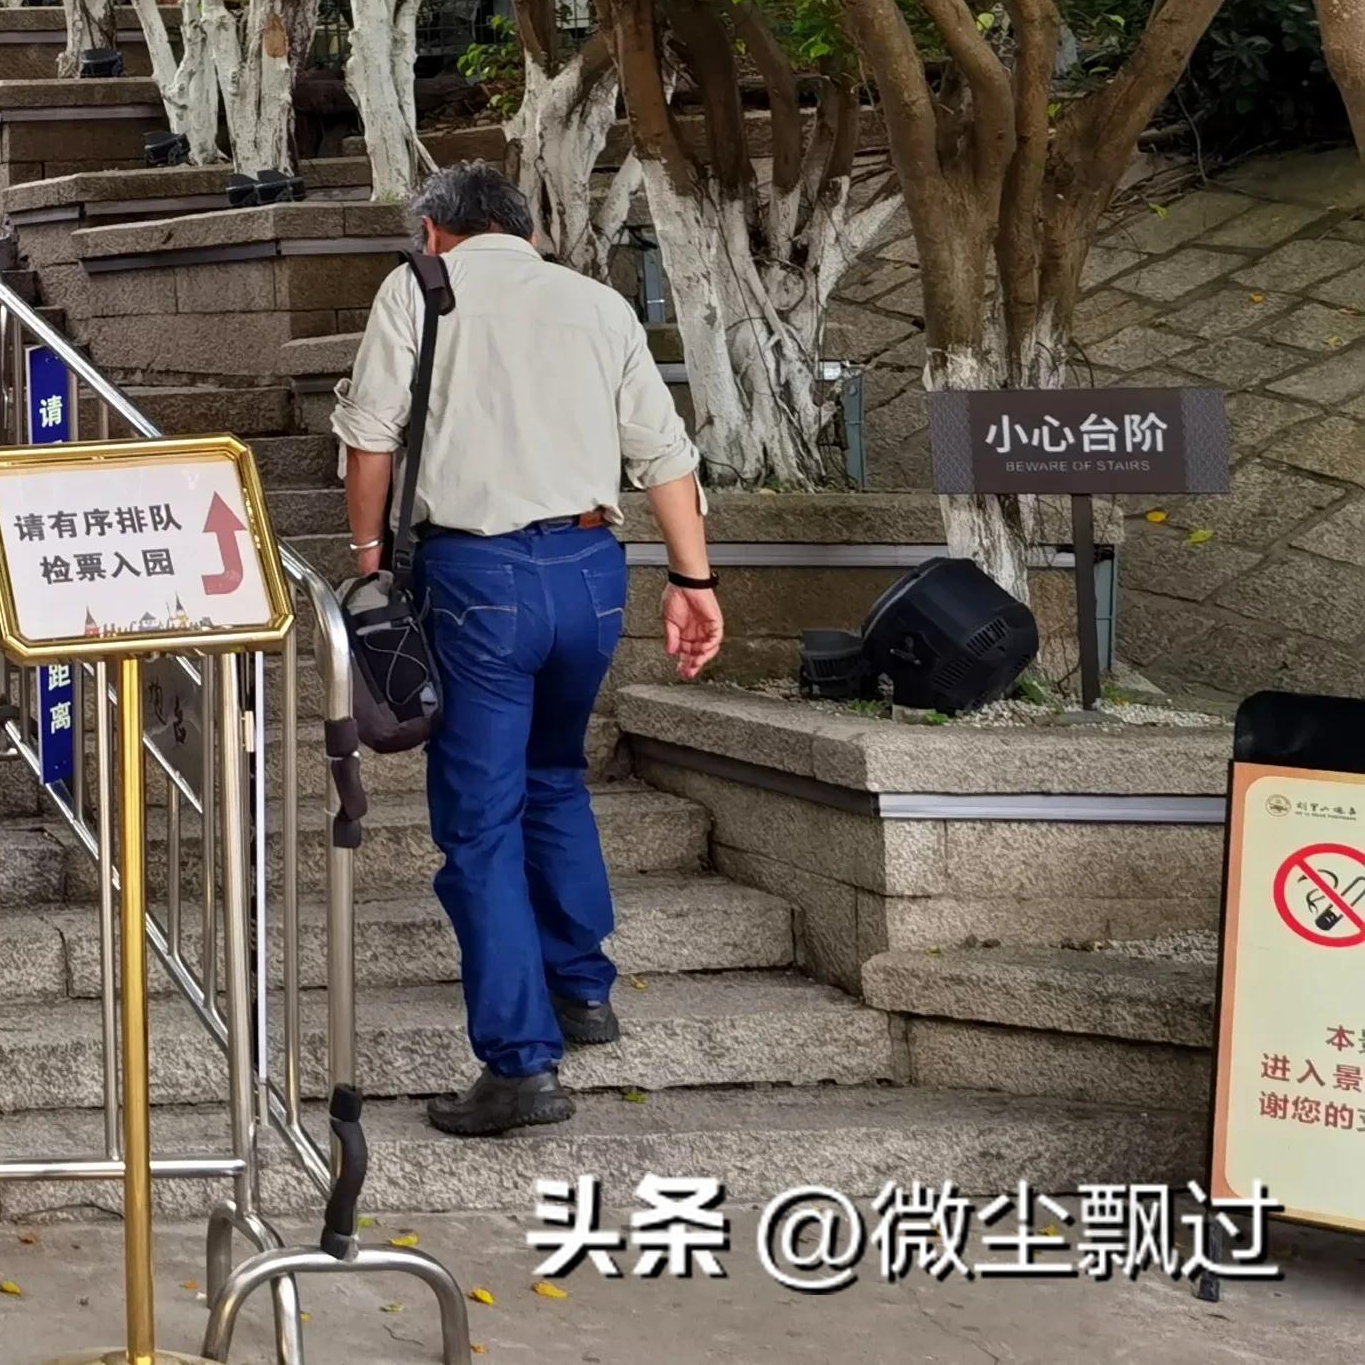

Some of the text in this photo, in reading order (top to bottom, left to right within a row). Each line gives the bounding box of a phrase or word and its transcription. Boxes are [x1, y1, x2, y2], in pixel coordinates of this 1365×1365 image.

[985, 412, 1168, 454] 小心台阶
[1005, 460, 1151, 472] BEWARE OF STAIRS
[13, 503, 183, 542] 请有序排队
[39, 548, 175, 585] 检票入园
[1325, 1024, 1365, 1055] 本
[1261, 1052, 1364, 1093] 进入景
